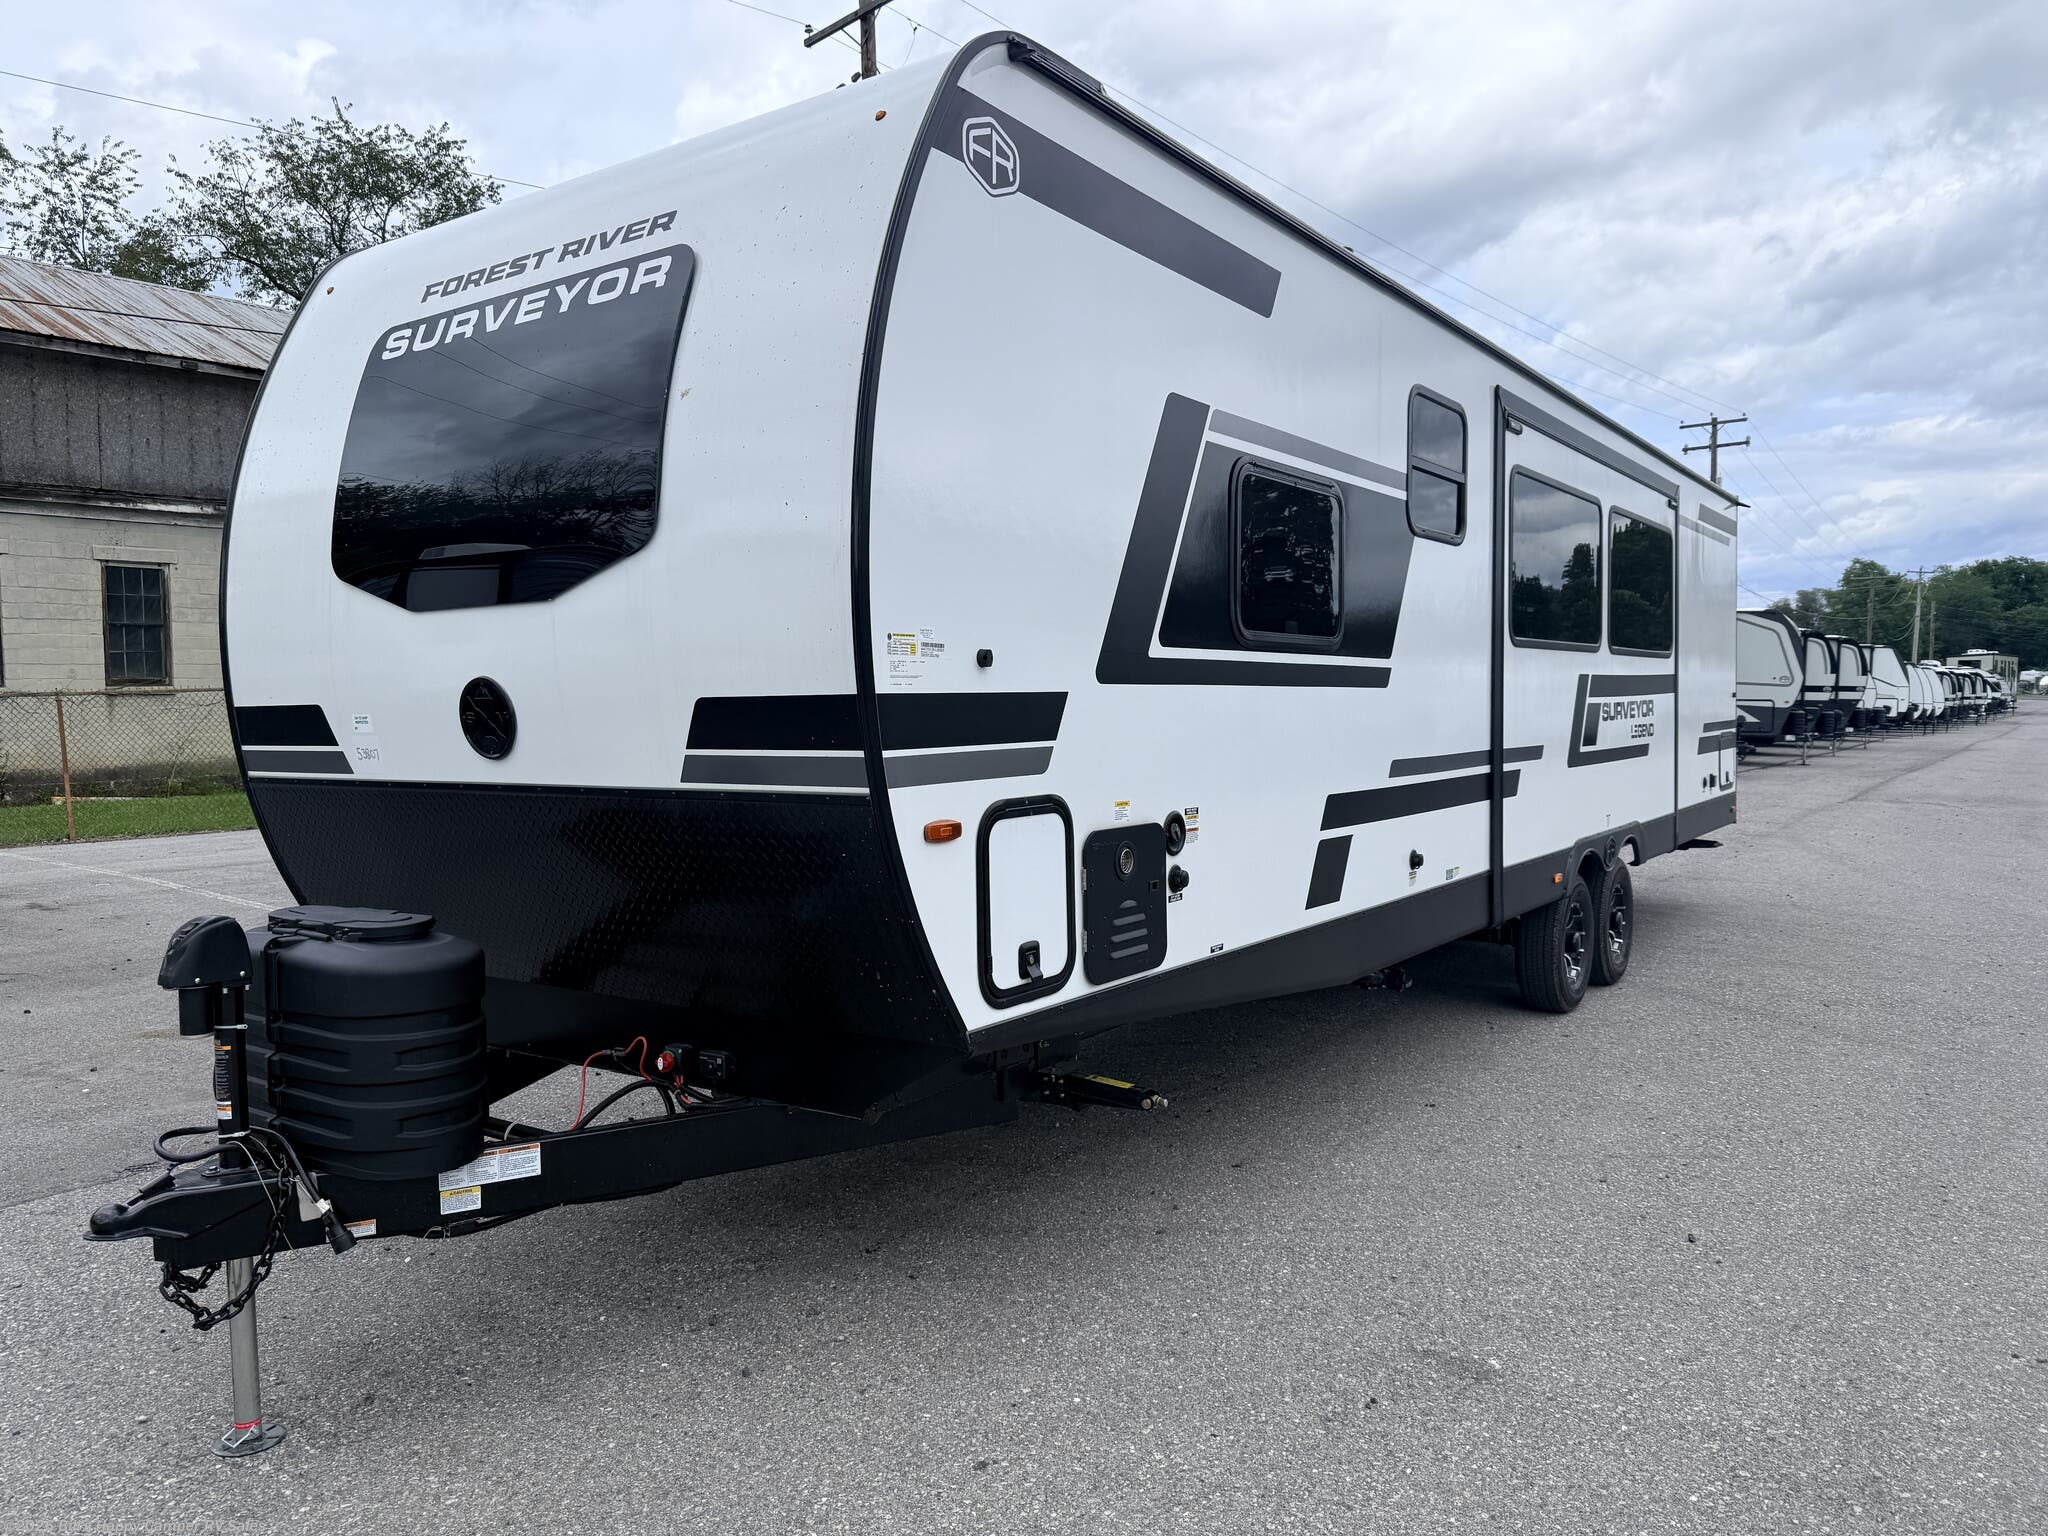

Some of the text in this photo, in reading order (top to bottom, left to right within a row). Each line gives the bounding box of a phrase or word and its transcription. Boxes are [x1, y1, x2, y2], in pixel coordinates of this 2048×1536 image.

[420, 210, 678, 304] FOREST RIVER
[381, 255, 673, 361] SURVEYOR
[1602, 699, 1655, 721] SURVEYOR
[1630, 723, 1655, 739] LEGEND
